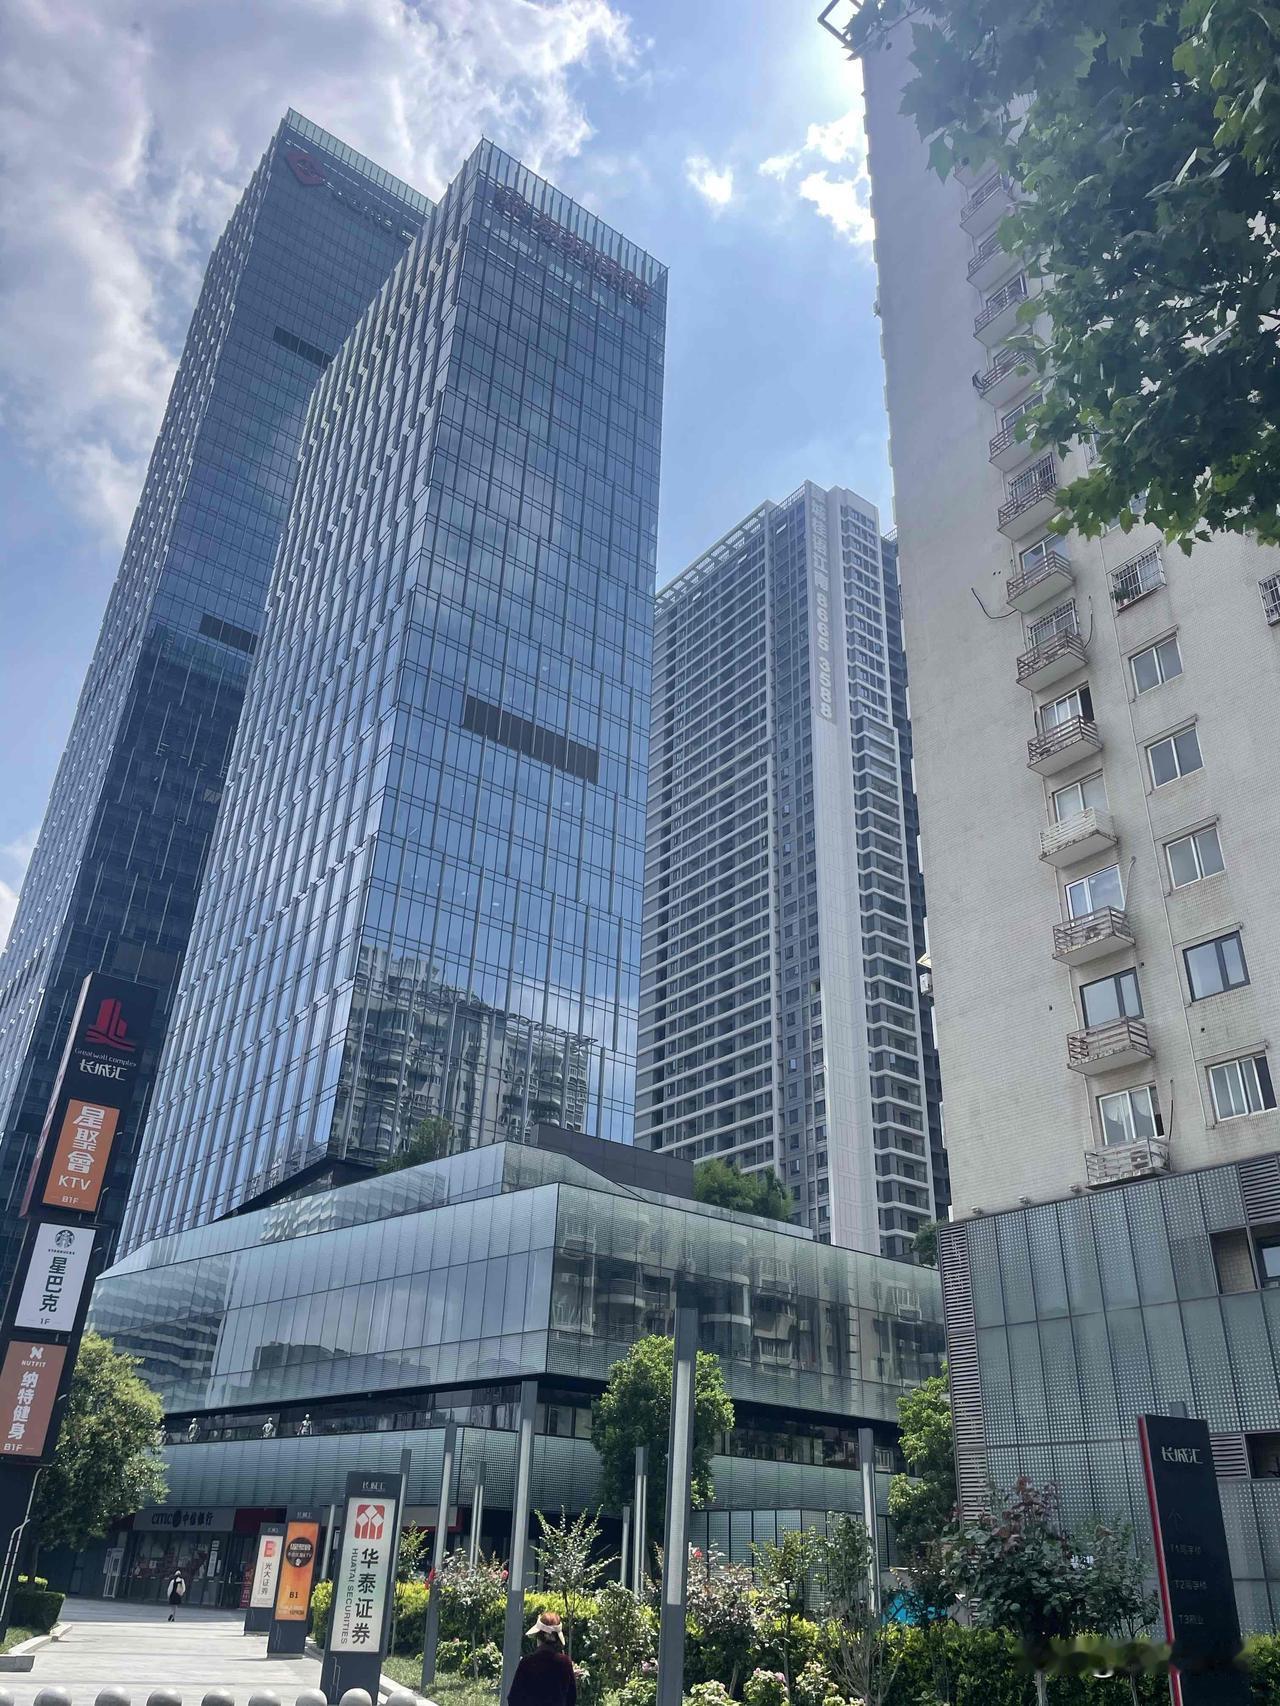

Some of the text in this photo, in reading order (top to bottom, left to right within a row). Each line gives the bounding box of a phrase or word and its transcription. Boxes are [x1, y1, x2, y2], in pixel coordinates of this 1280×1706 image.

[58, 1174, 91, 1191] KTV
[62, 1195, 79, 1205] B1F
[39, 1256, 67, 1313] 星巴克
[40, 1318, 51, 1326] 1F
[8, 1371, 39, 1440] 纳特健身
[4, 1443, 23, 1452] B1F
[341, 1548, 358, 1644] HUATAI SECURITIES
[352, 1547, 379, 1645] 华泰证券
